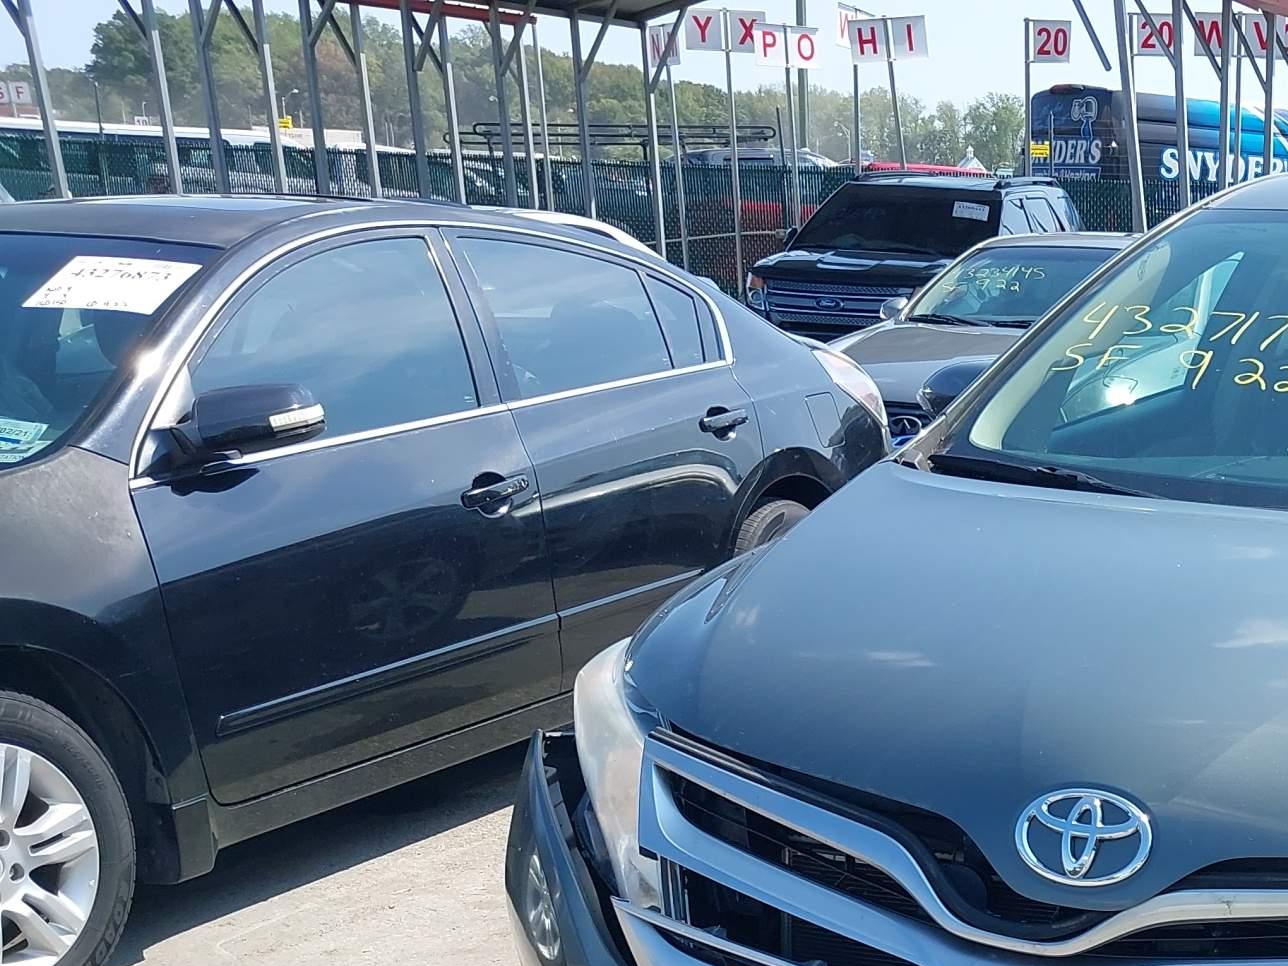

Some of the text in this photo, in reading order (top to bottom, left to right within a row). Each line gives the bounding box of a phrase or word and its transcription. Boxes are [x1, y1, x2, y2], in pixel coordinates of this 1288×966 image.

[691, 15, 712, 43] Y
[738, 18, 757, 45] X
[857, 26, 878, 56] H
[906, 23, 914, 52] I
[1036, 27, 1068, 56] 20
[1140, 20, 1173, 49] 20
[762, 30, 777, 57] P
[797, 33, 815, 61] O
[16, 85, 25, 99] F
[1179, 350, 1214, 390] 9
